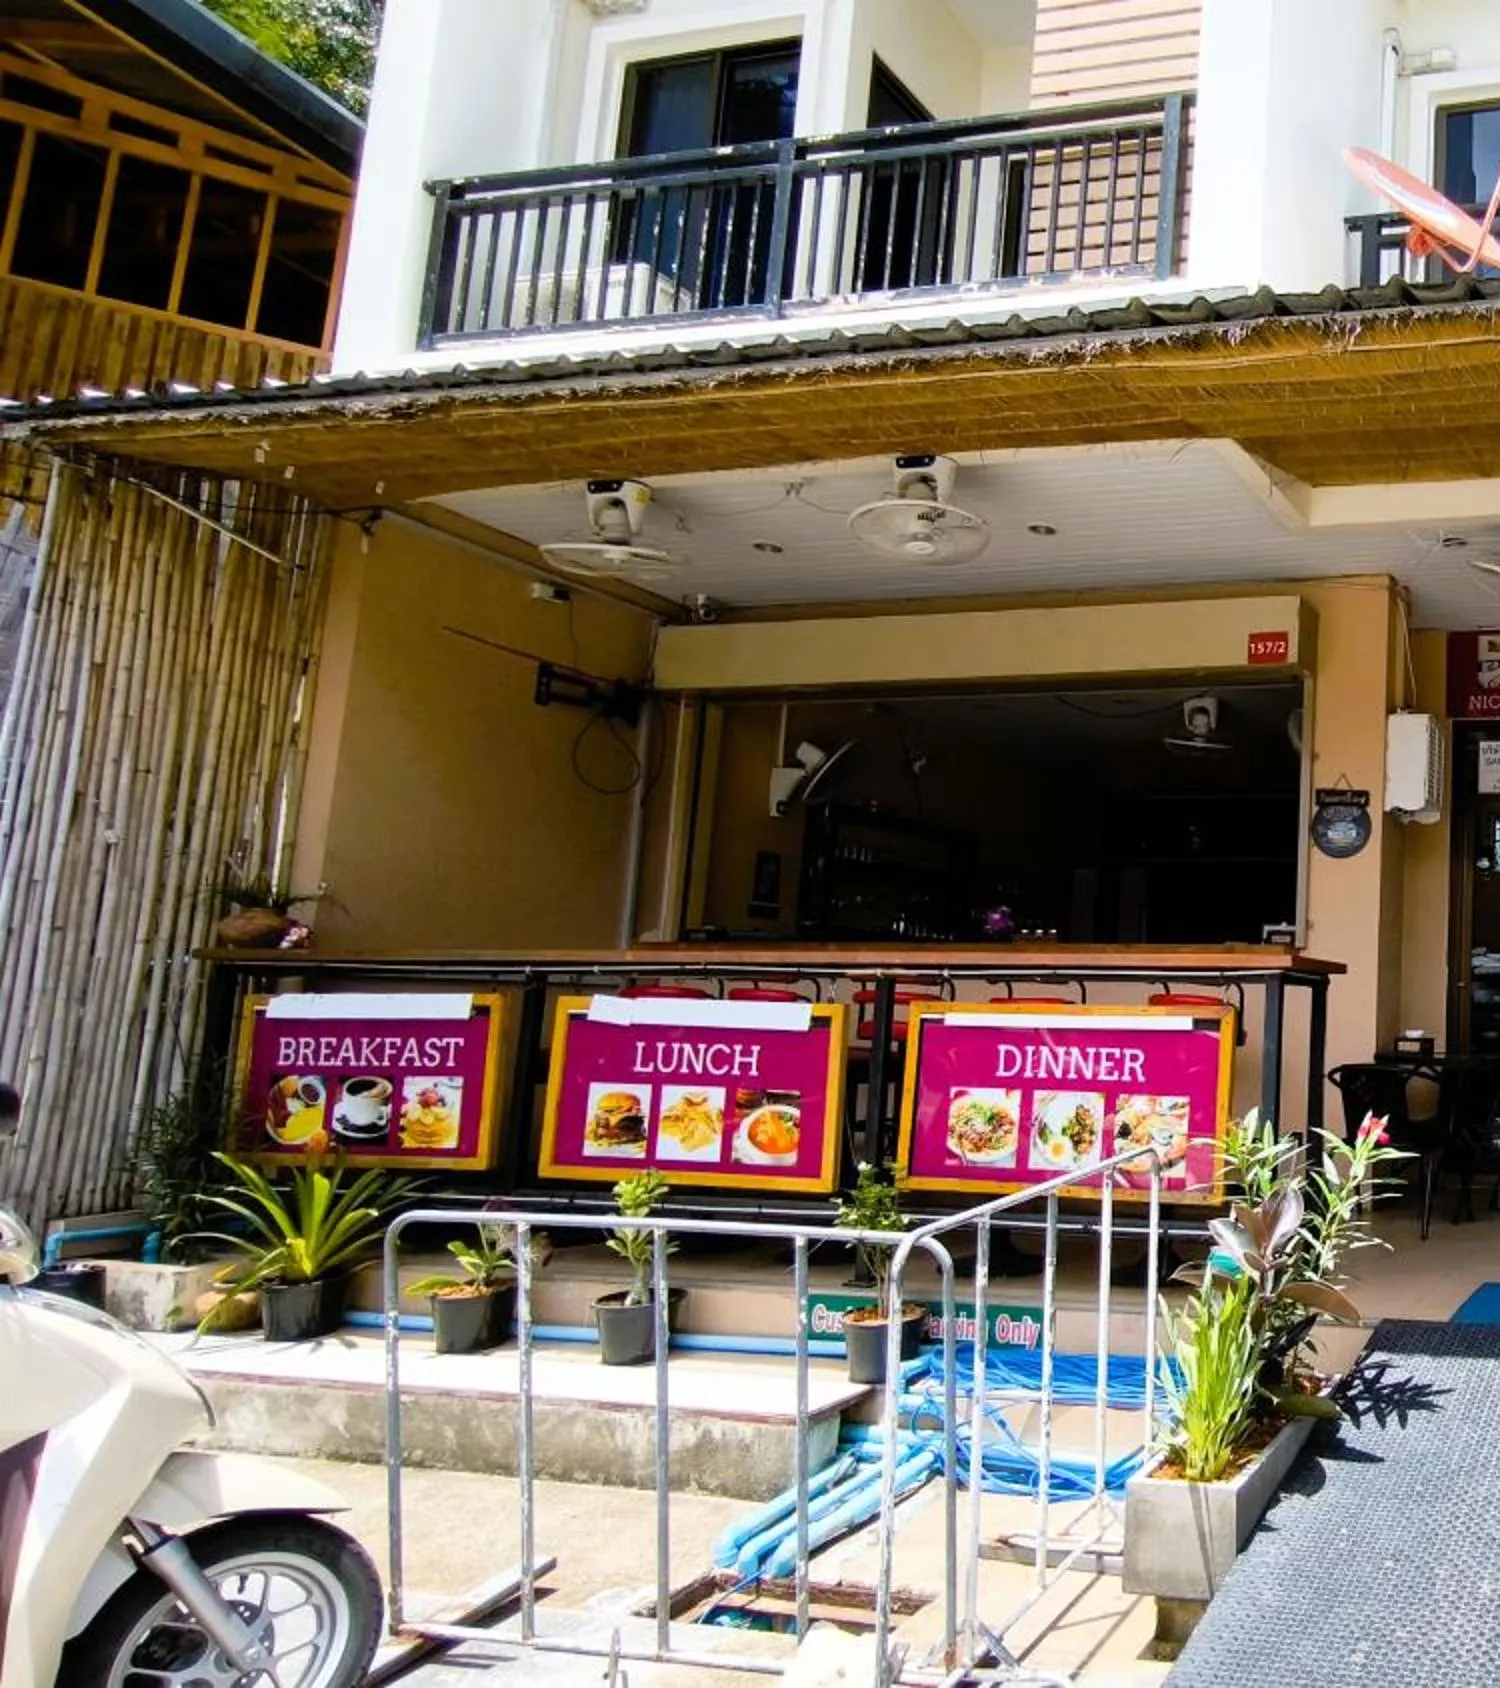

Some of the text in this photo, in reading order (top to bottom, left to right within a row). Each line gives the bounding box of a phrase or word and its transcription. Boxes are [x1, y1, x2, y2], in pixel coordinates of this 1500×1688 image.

[1250, 641, 1286, 655] 157/2
[277, 1036, 465, 1069] BREAKFAST
[632, 1041, 762, 1077] LUNCH
[995, 1043, 1147, 1084] DINNER
[995, 1312, 1042, 1350] Only
